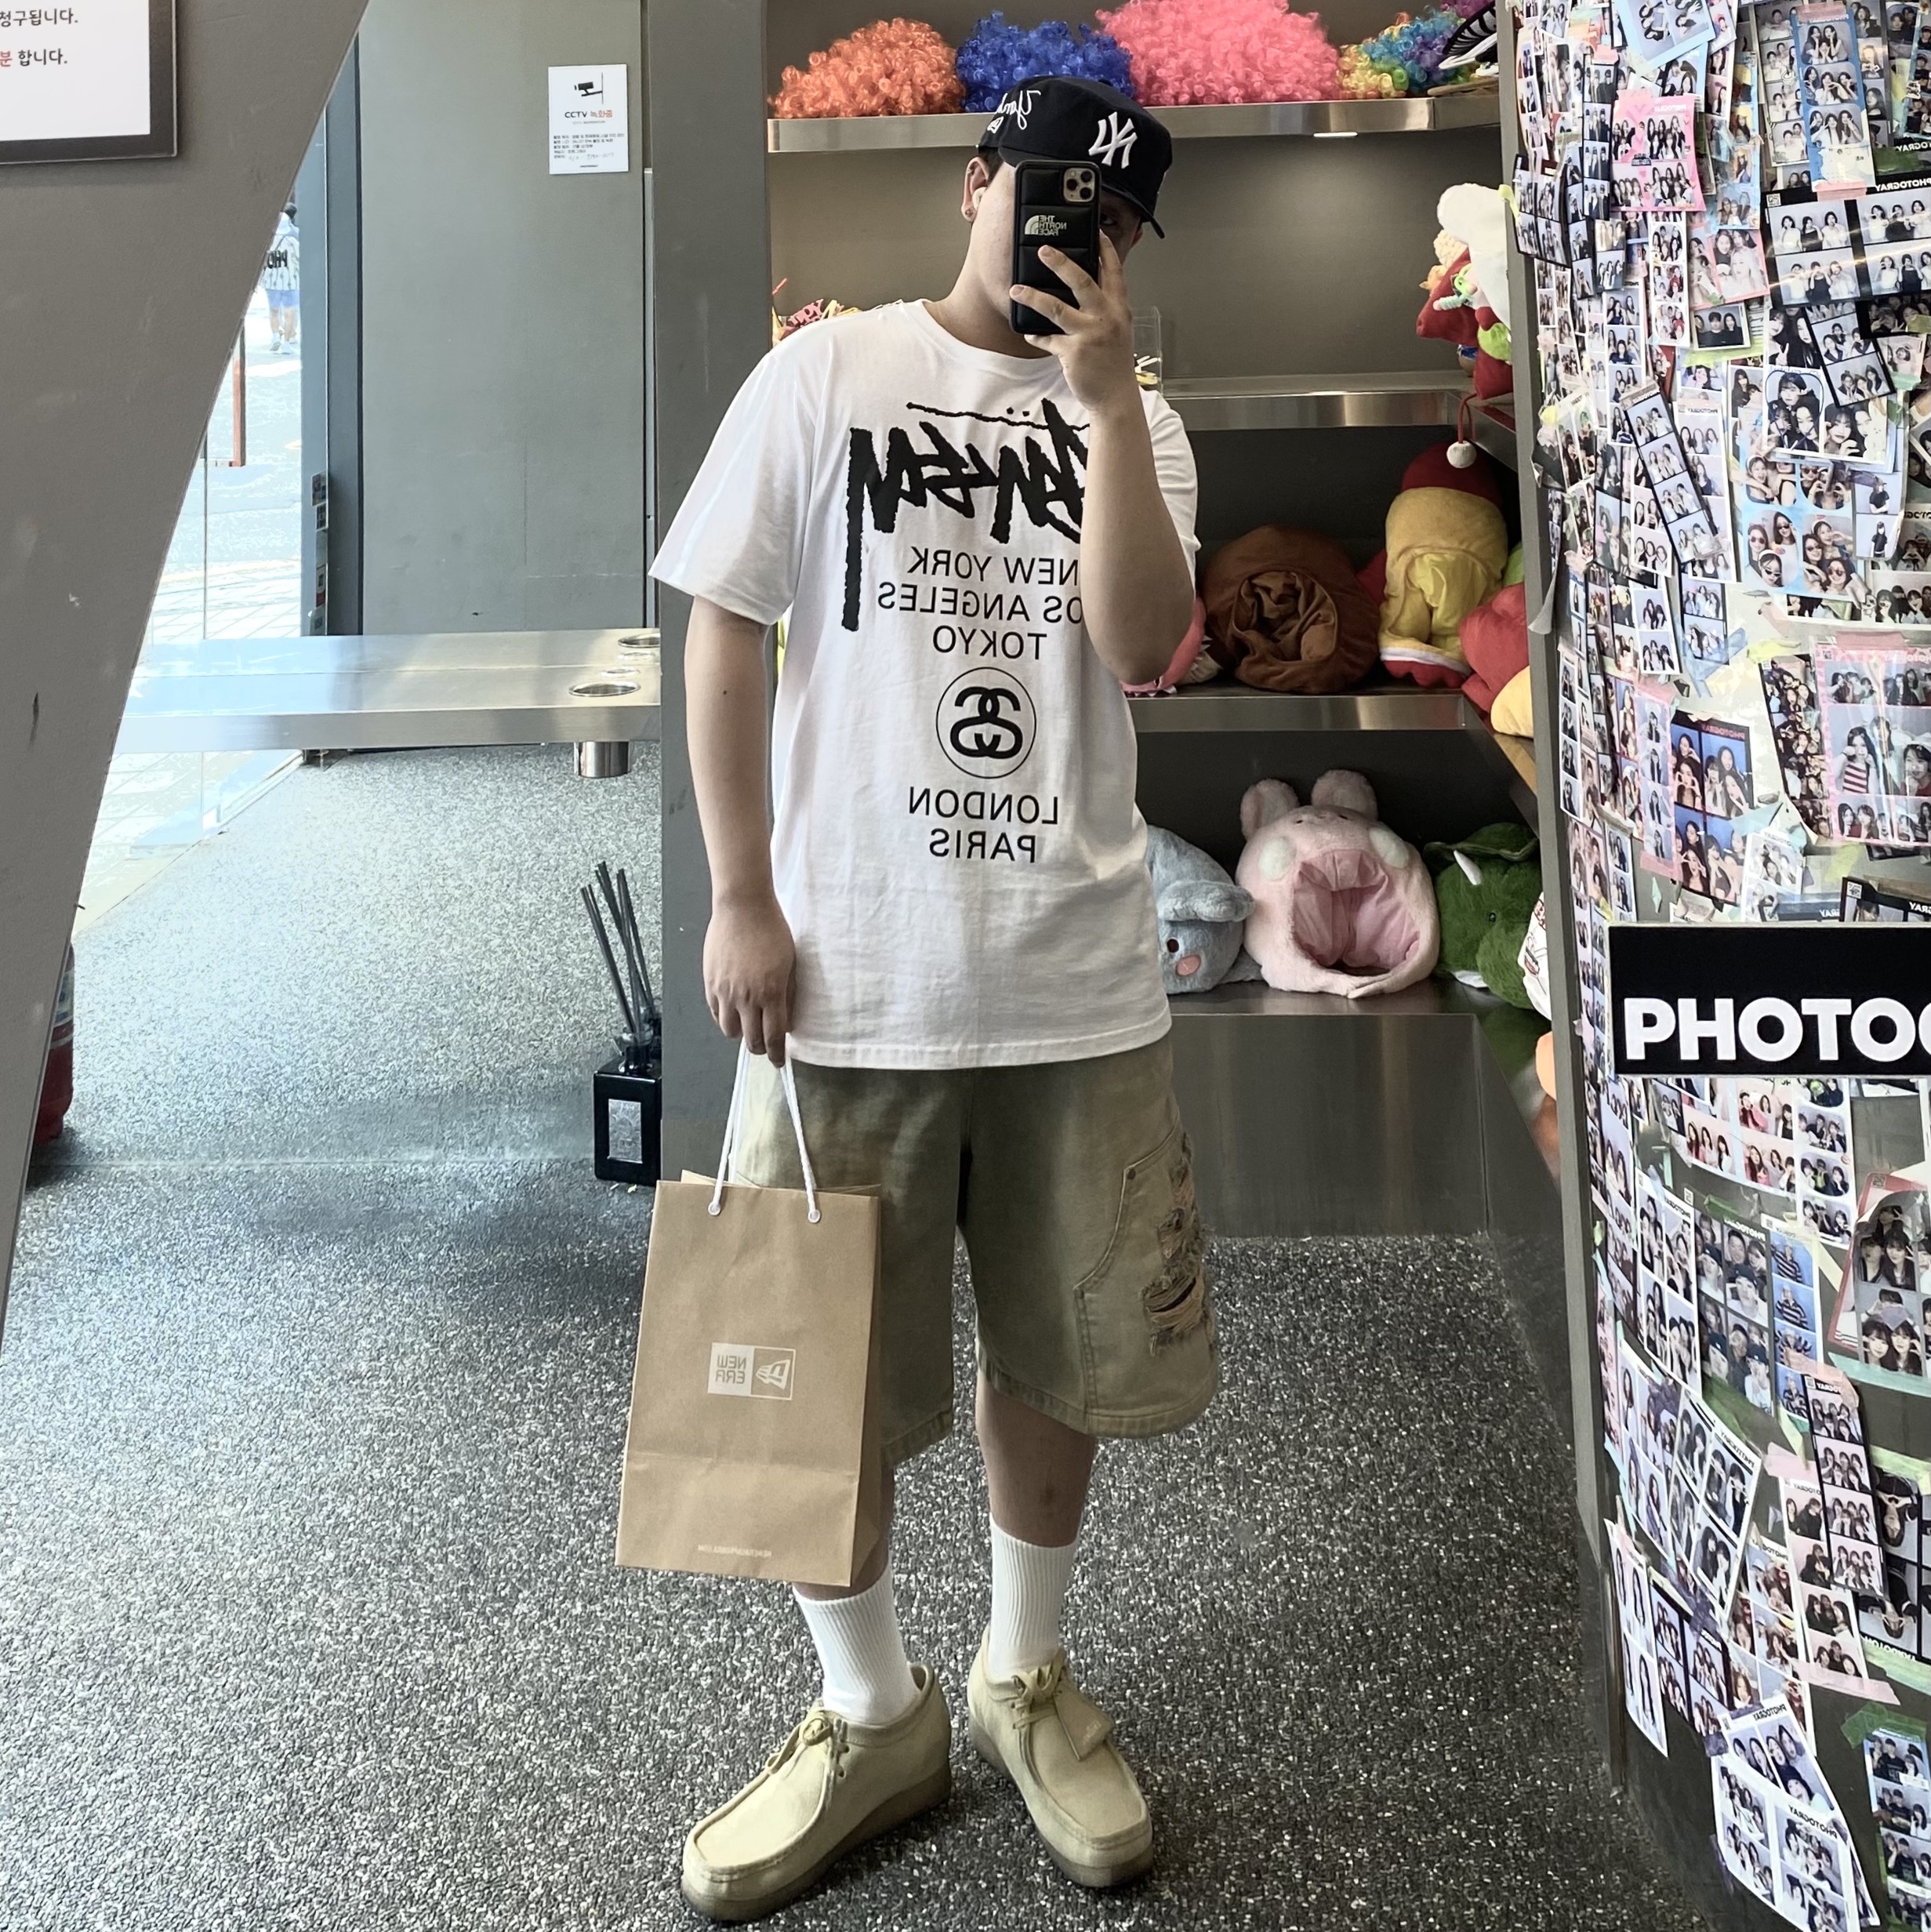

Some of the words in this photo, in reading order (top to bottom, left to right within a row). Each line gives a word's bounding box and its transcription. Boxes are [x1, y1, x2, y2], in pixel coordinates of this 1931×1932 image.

[0, 8, 78, 27] 청구됩니다.
[18, 49, 67, 67] 합니다.
[1624, 997, 1931, 1062] PHOTO
